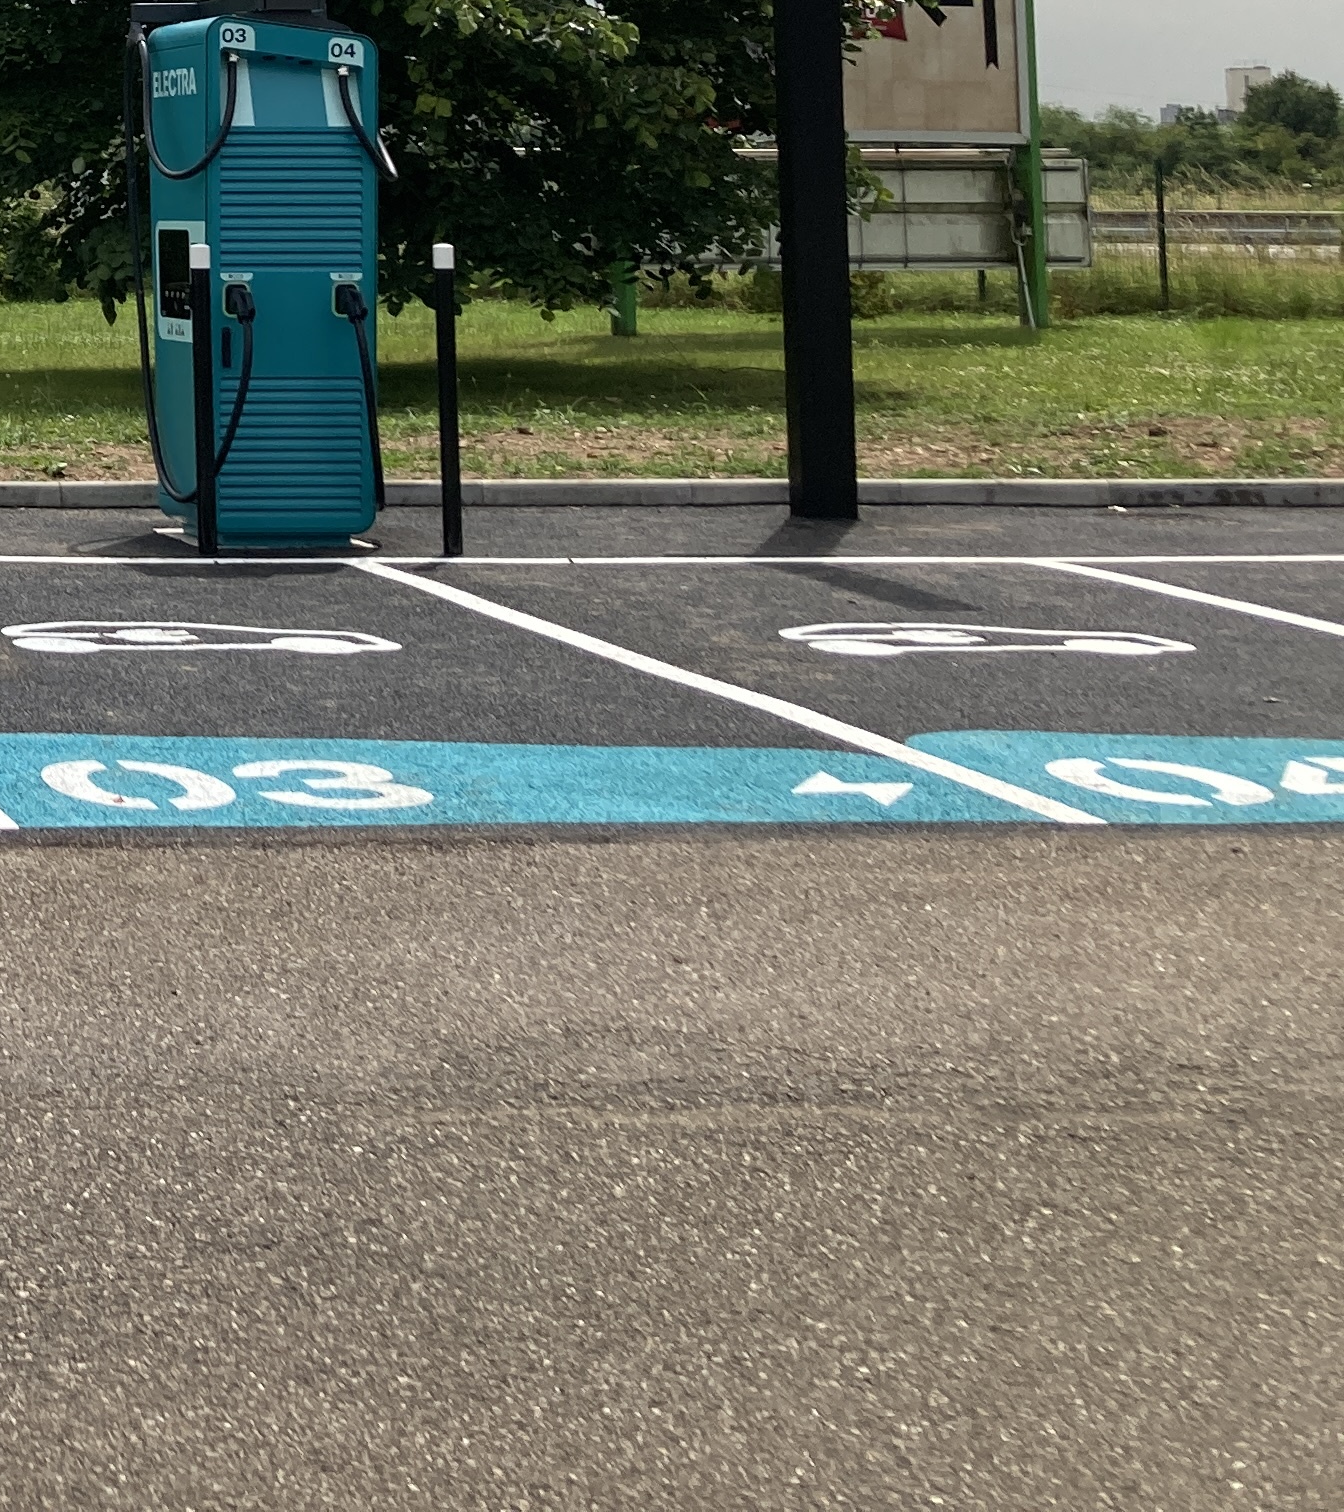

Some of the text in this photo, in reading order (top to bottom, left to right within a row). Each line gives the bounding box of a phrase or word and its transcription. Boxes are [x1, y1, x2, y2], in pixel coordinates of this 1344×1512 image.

[222, 28, 247, 43] 03
[330, 43, 356, 58] 04
[153, 67, 197, 98] ELECTRA
[41, 759, 434, 811] 03
